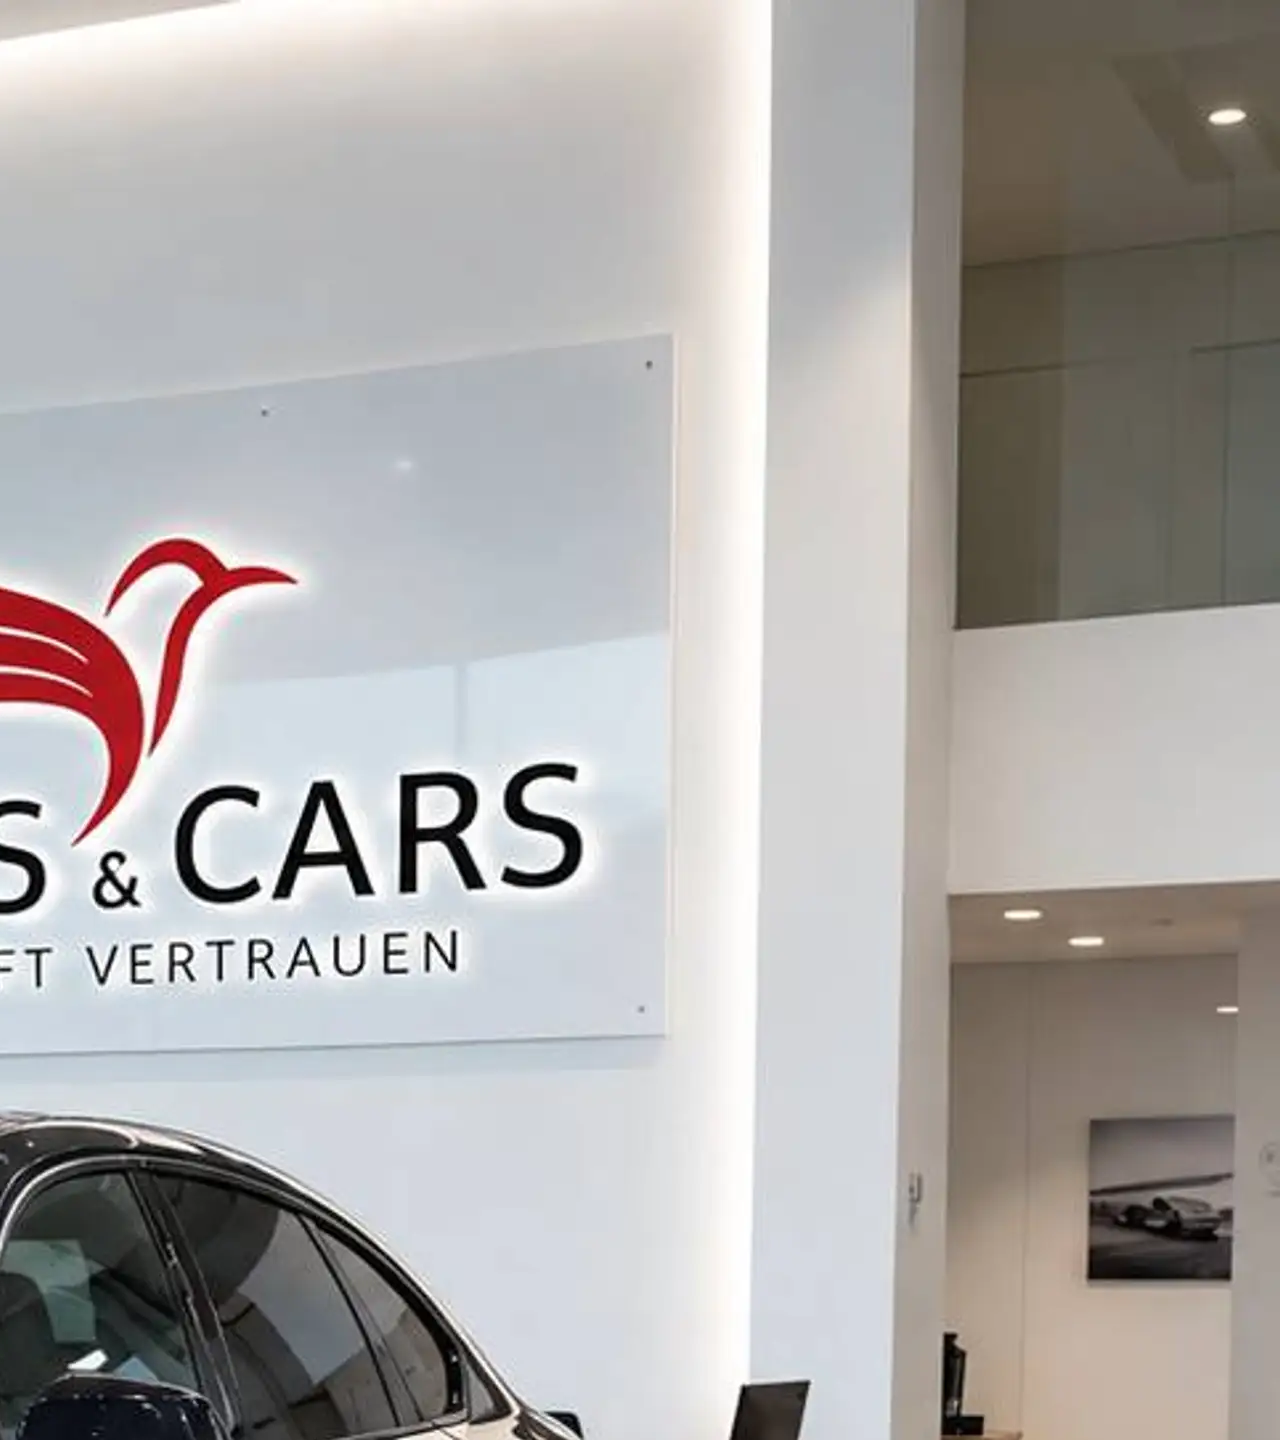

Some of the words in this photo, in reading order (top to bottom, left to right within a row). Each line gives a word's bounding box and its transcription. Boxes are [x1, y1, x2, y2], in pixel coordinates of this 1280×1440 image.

[91, 849, 142, 910] &
[173, 762, 584, 905] CARS
[84, 929, 458, 987] VERTRAUEN
